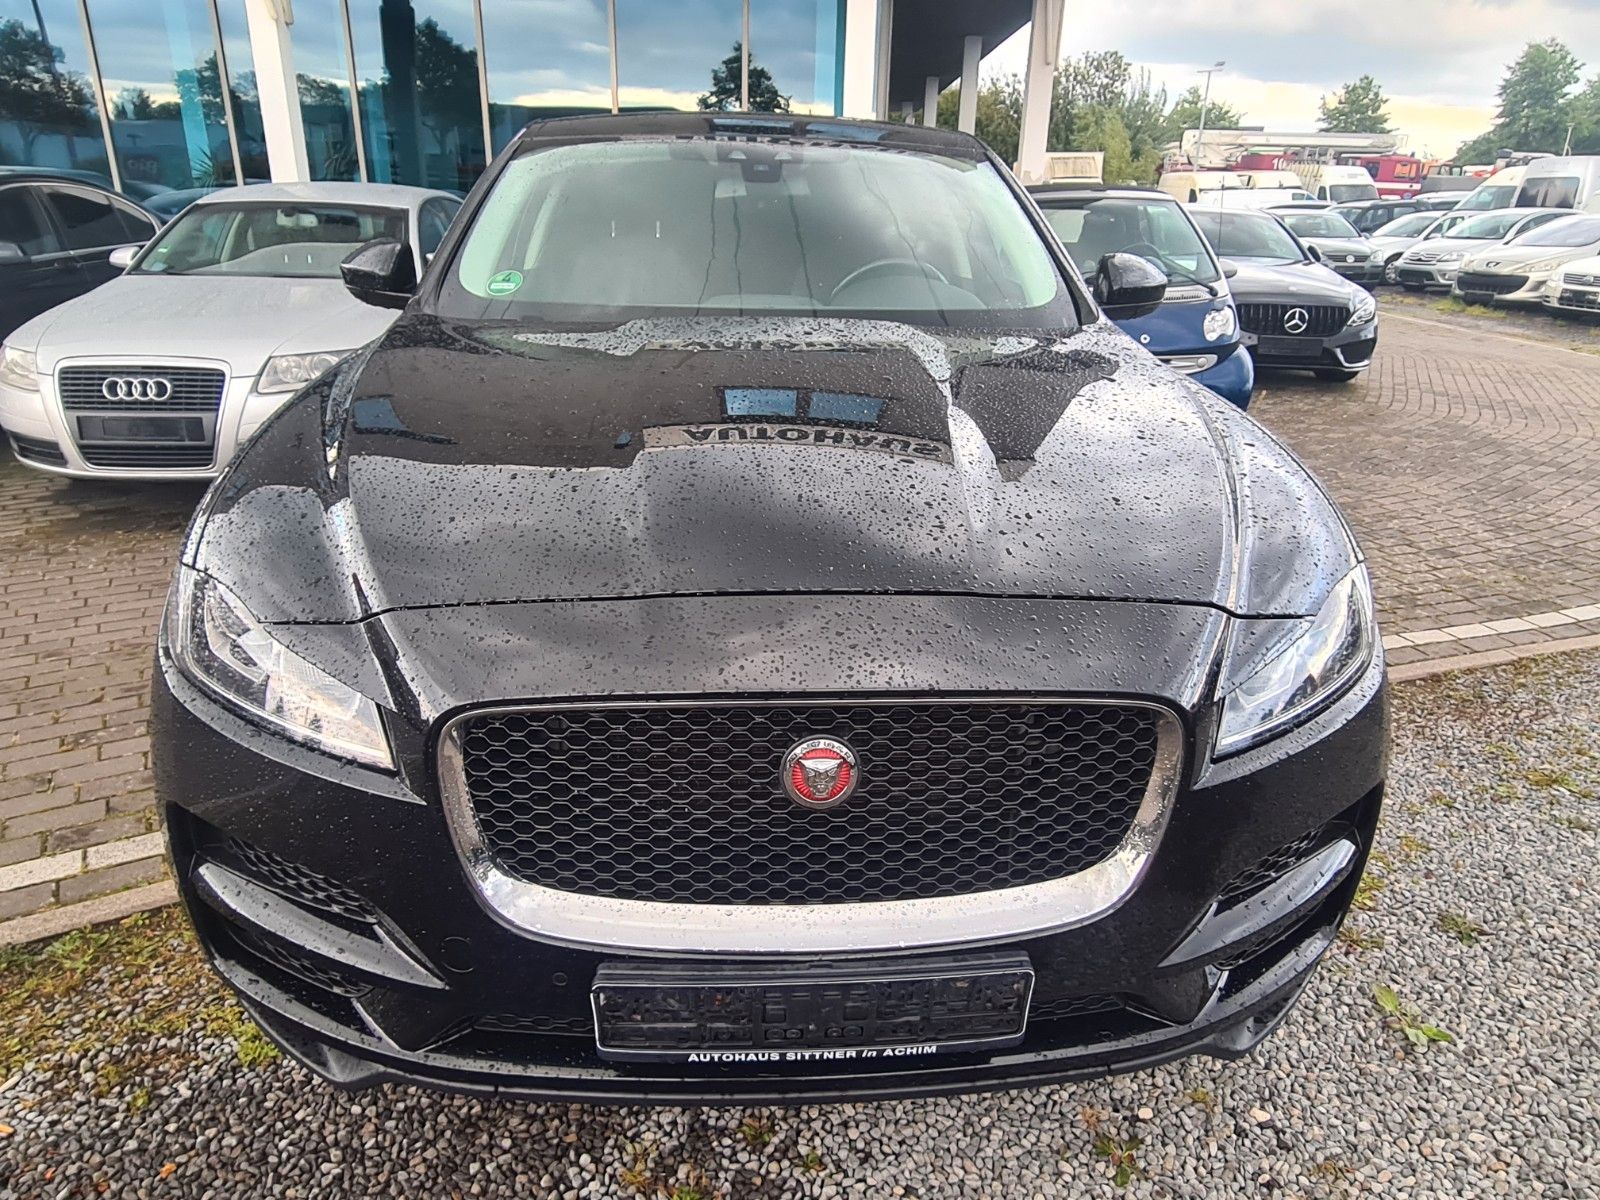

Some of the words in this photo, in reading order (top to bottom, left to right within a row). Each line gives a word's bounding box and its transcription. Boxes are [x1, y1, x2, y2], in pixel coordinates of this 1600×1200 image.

[688, 1053, 780, 1062] AUTOHAUS
[786, 1050, 856, 1060] SITTNER
[862, 1049, 877, 1058] in
[883, 1045, 937, 1056] ACHIM
